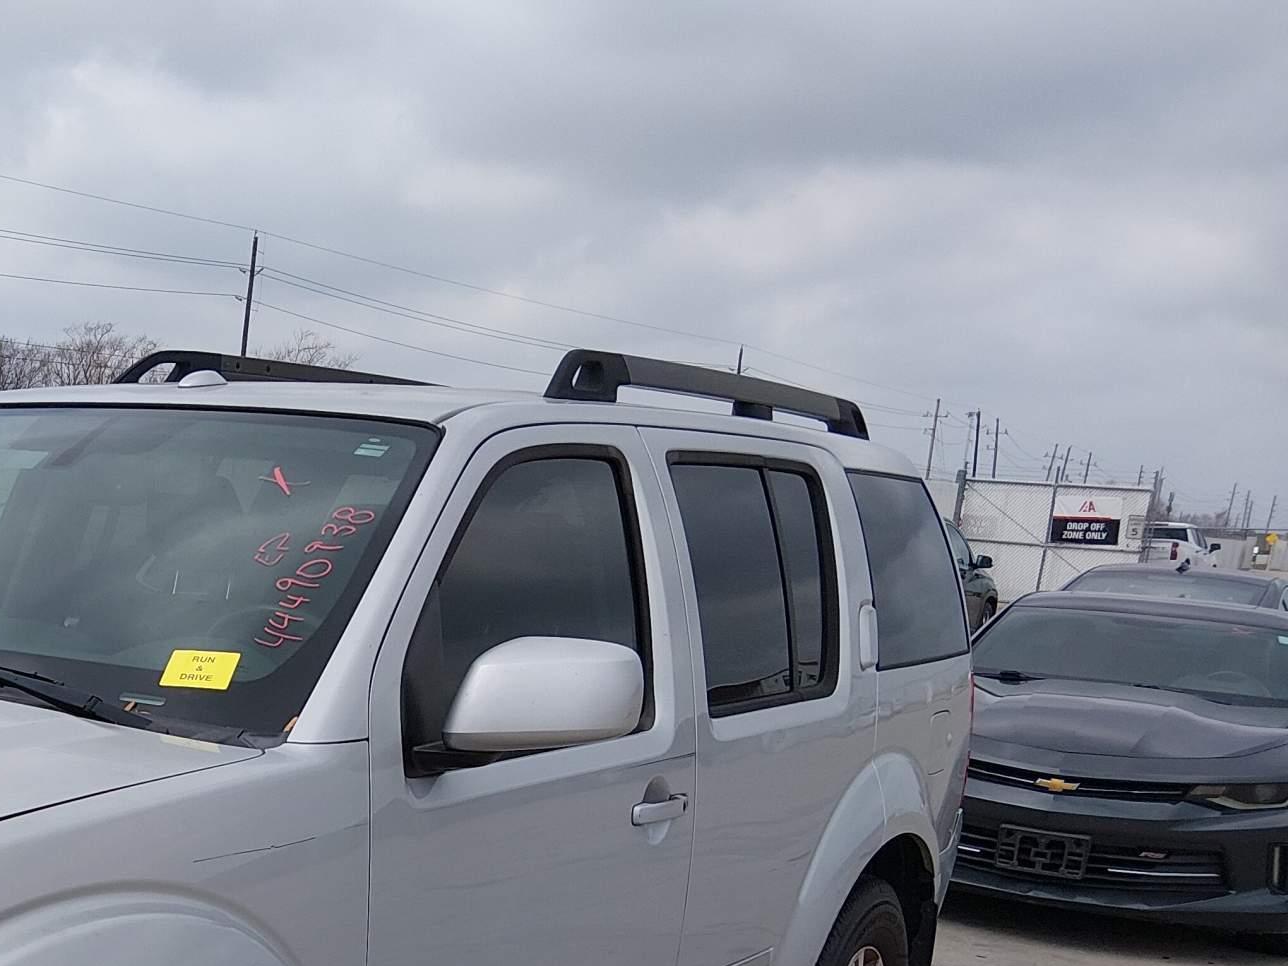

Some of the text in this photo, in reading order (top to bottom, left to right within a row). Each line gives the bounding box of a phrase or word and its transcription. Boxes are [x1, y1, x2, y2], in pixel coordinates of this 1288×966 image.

[1066, 521, 1107, 531] DROP OFF
[1062, 530, 1108, 540] ZONE ONLY
[254, 507, 375, 647] 44490938
[191, 655, 216, 664] RUN
[195, 664, 203, 672] &
[179, 673, 214, 682] DRIVE
